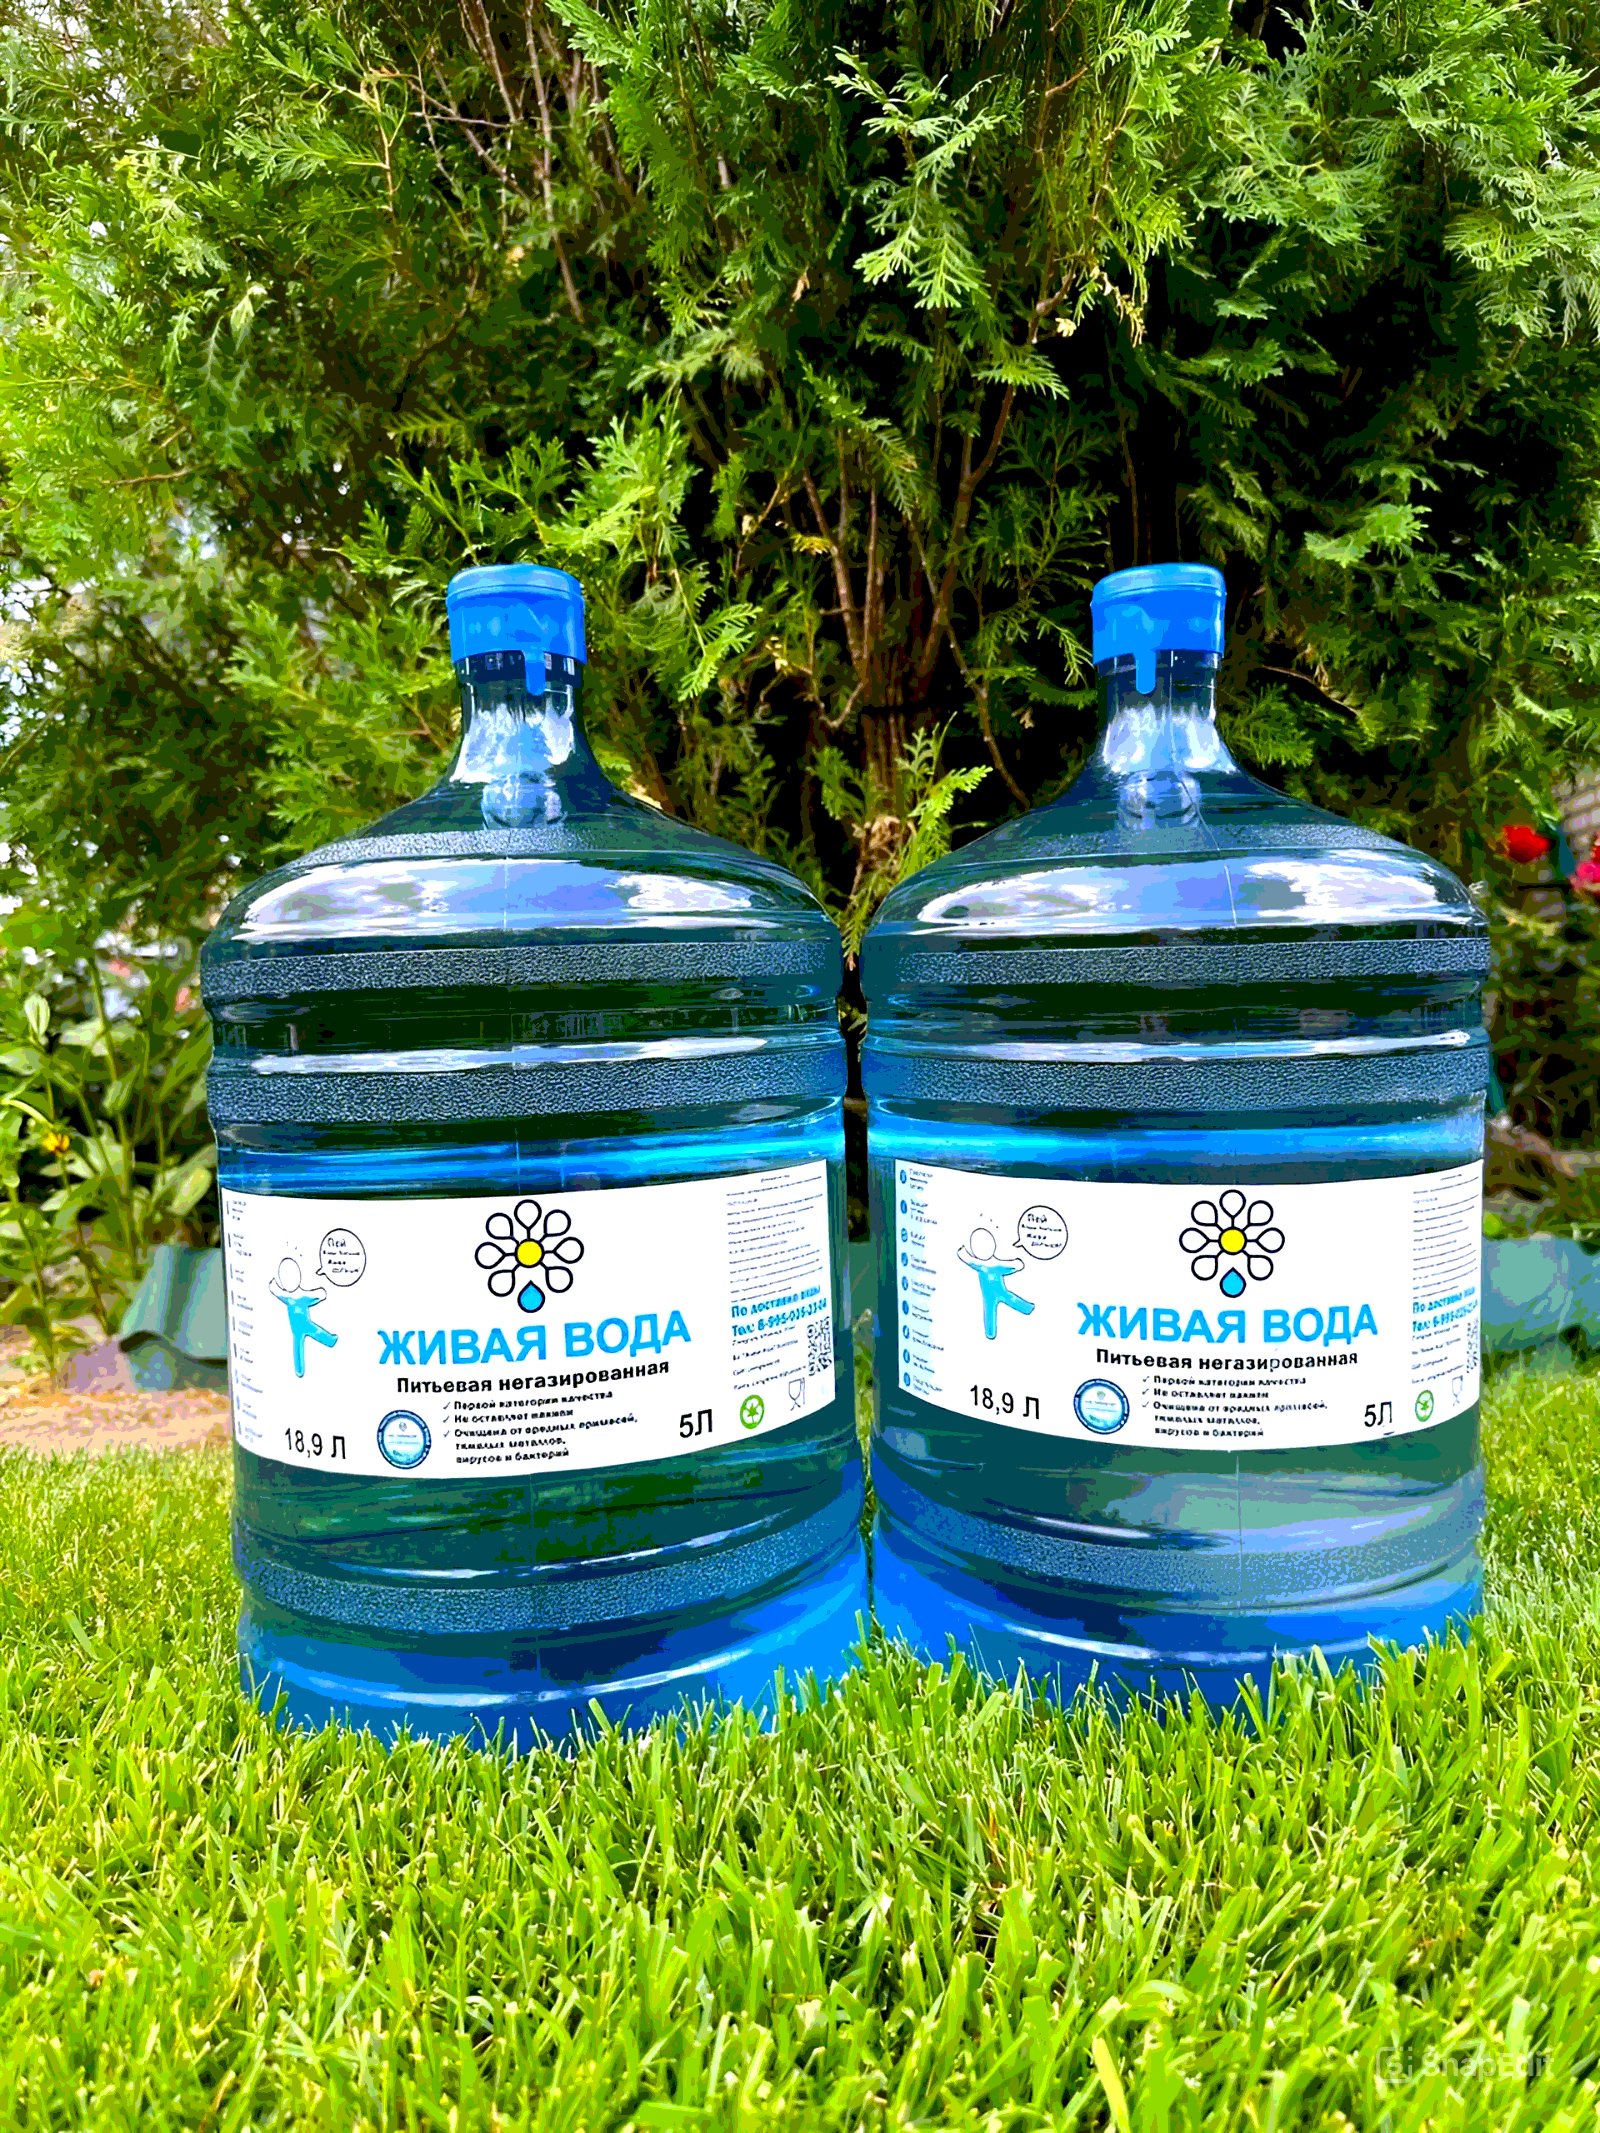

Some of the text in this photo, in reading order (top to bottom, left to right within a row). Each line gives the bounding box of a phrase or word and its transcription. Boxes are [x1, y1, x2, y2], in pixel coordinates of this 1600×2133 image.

[377, 1325, 547, 1366] ЖИВАЯ
[564, 1310, 692, 1358] ВОДА
[1076, 1302, 1379, 1347] ЖИВАЯ ВОДА
[1096, 1348, 1359, 1373] Питьевая негазированная
[396, 1361, 670, 1393] Питьевая негазированная
[1153, 1375, 1196, 1386] Первой
[454, 1391, 613, 1411] Первой категории качества
[970, 1384, 1014, 1415] 18,9
[1022, 1397, 1041, 1419] Л
[1153, 1388, 1168, 1397] Не
[454, 1414, 468, 1423] Не
[678, 1408, 713, 1438] 5Л
[1364, 1401, 1393, 1428] 5Л
[284, 1427, 323, 1458] 18,9
[331, 1435, 346, 1459] Л
[510, 1426, 523, 1435] от
